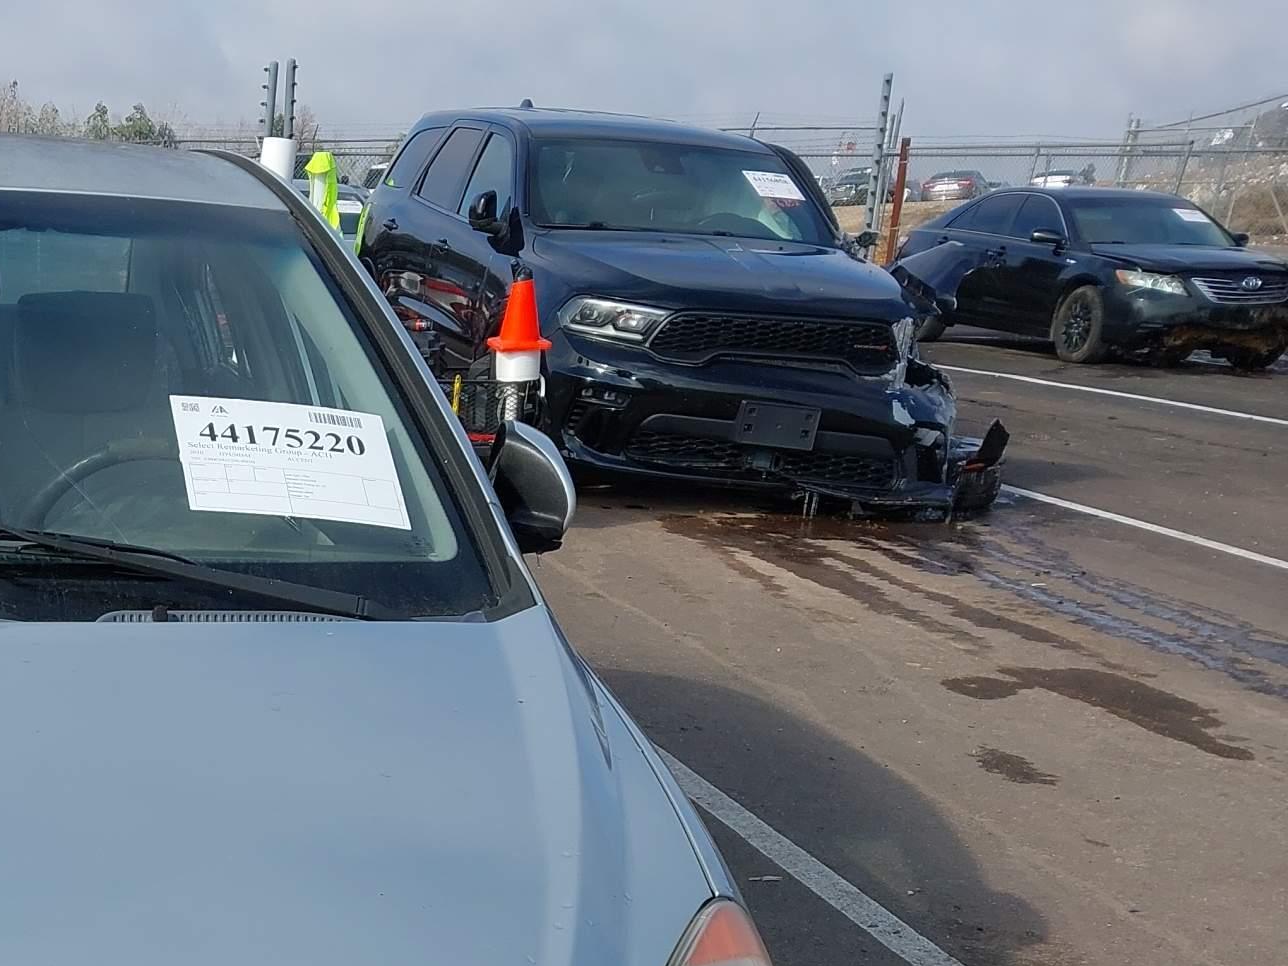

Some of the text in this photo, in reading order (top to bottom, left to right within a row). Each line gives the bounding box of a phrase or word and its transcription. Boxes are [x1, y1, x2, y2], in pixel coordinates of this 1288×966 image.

[187, 441, 214, 450] Select
[217, 443, 273, 454] Remarketing
[275, 447, 303, 457] Group
[199, 422, 366, 456] 44175220
